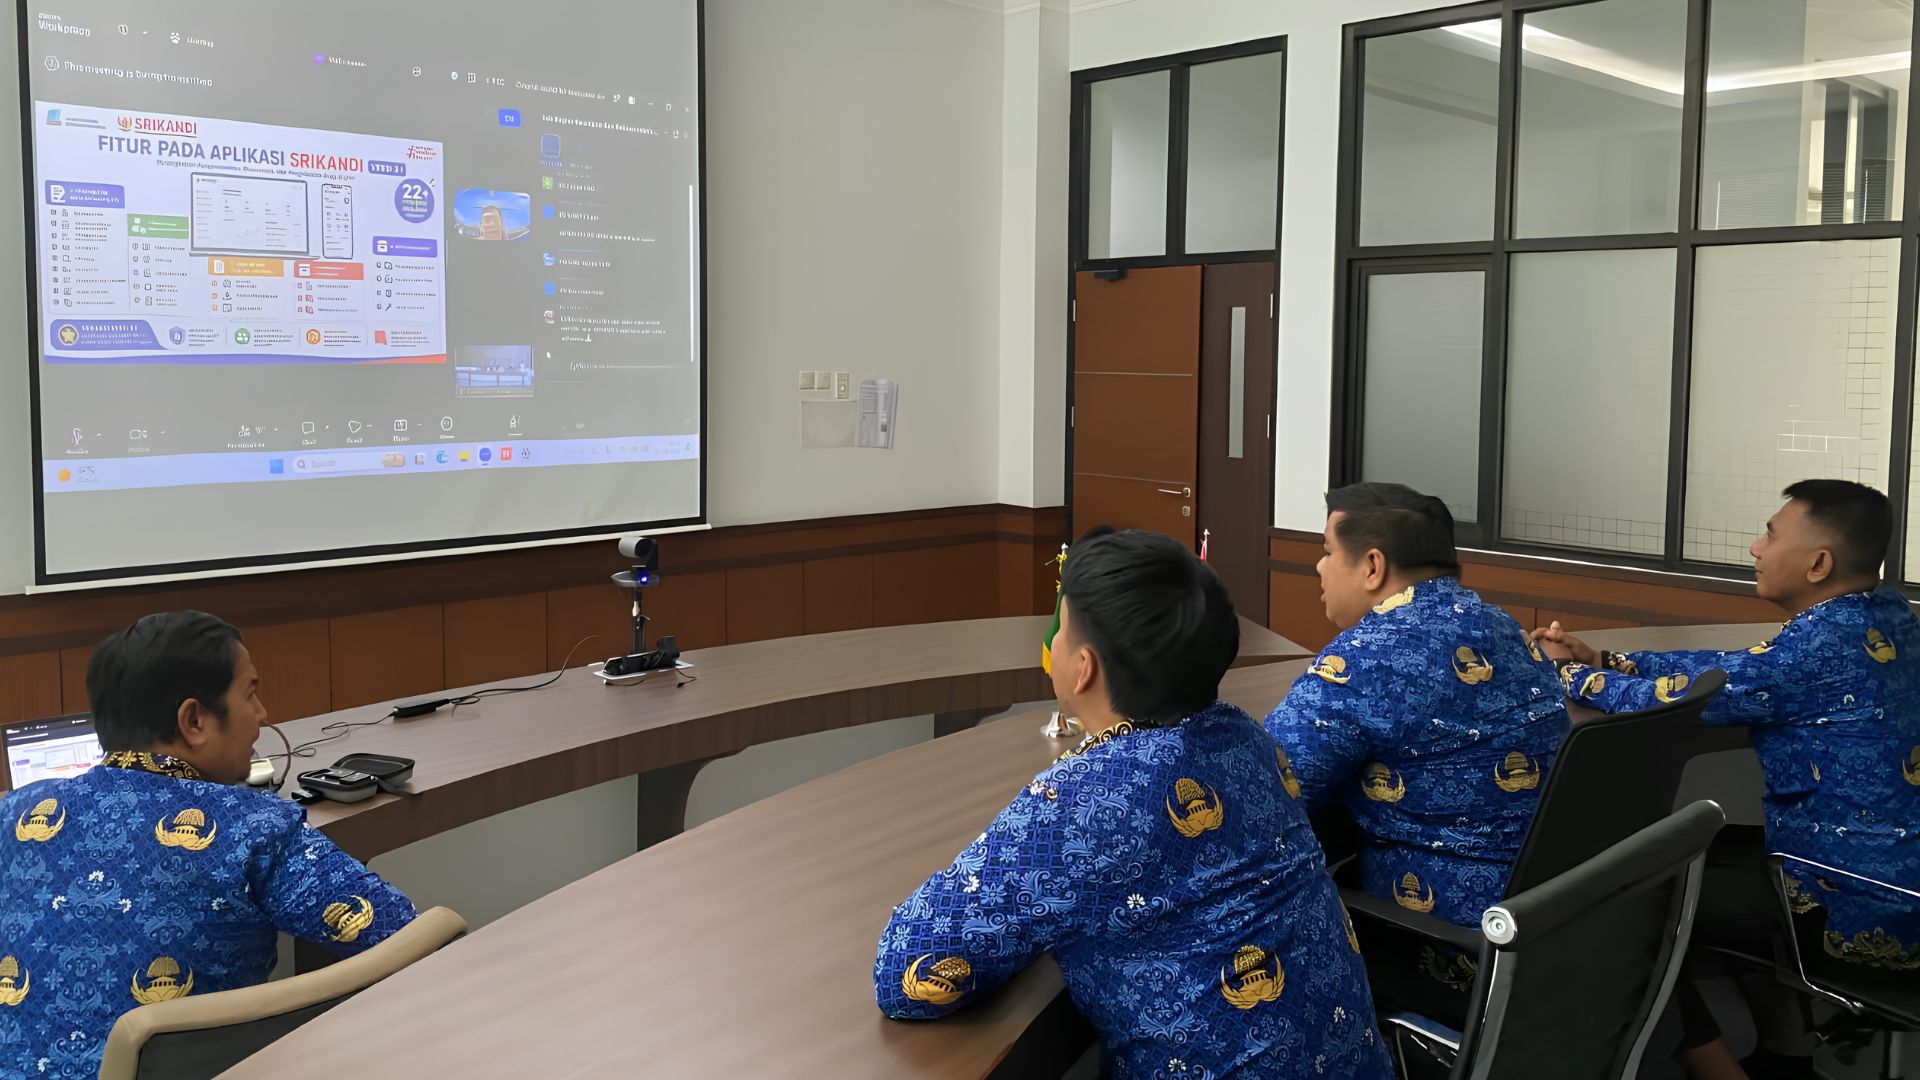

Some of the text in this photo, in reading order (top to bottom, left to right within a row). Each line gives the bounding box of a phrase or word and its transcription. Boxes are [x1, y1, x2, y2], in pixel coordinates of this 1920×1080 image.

[134, 118, 197, 135] SRIKANDI
[98, 135, 152, 155] FITUR
[158, 140, 206, 160] PADA
[210, 145, 285, 166] APLIKASI
[290, 152, 363, 173] SRIKANDI
